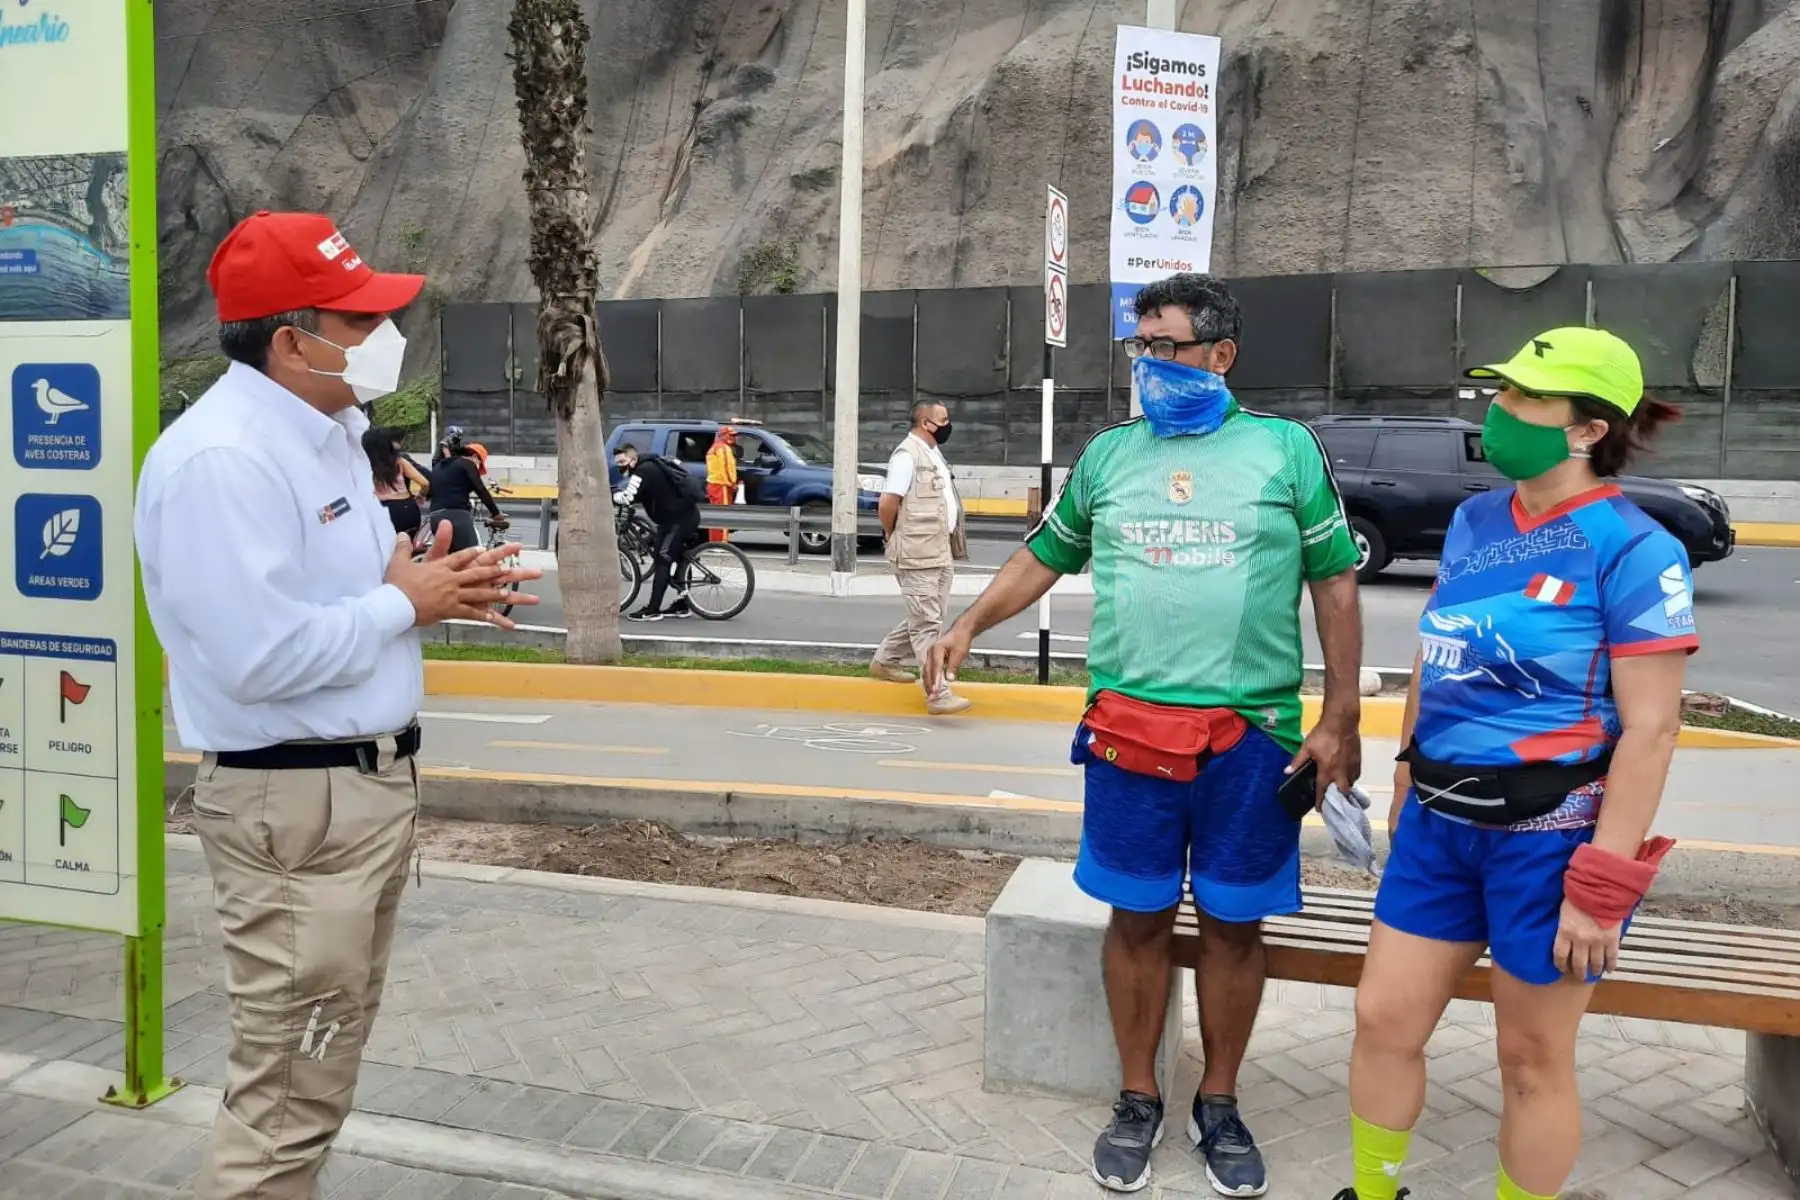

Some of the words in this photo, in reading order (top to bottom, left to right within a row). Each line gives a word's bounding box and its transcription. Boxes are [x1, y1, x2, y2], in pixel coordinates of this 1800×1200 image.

[1126, 50, 1206, 77] ¡Sigamos
[1122, 74, 1208, 100] Luchando!
[1121, 95, 1156, 108] Contra
[1158, 99, 1168, 109] el
[1169, 101, 1208, 114] Covid-19
[1127, 257, 1193, 272] #PerUnidos
[28, 434, 74, 446] PRESENCIA
[74, 435, 87, 446] DE
[24, 449, 46, 460] AVES
[46, 449, 91, 461] COSTERAS
[1119, 519, 1237, 544] SIEMENS
[57, 576, 90, 588] VERDES
[0, 637, 47, 650] BANDERAS
[48, 641, 60, 652] DE
[62, 641, 113, 656] SEGURIDAD
[48, 740, 92, 754] PELIGRO
[55, 859, 90, 872] CALMA
